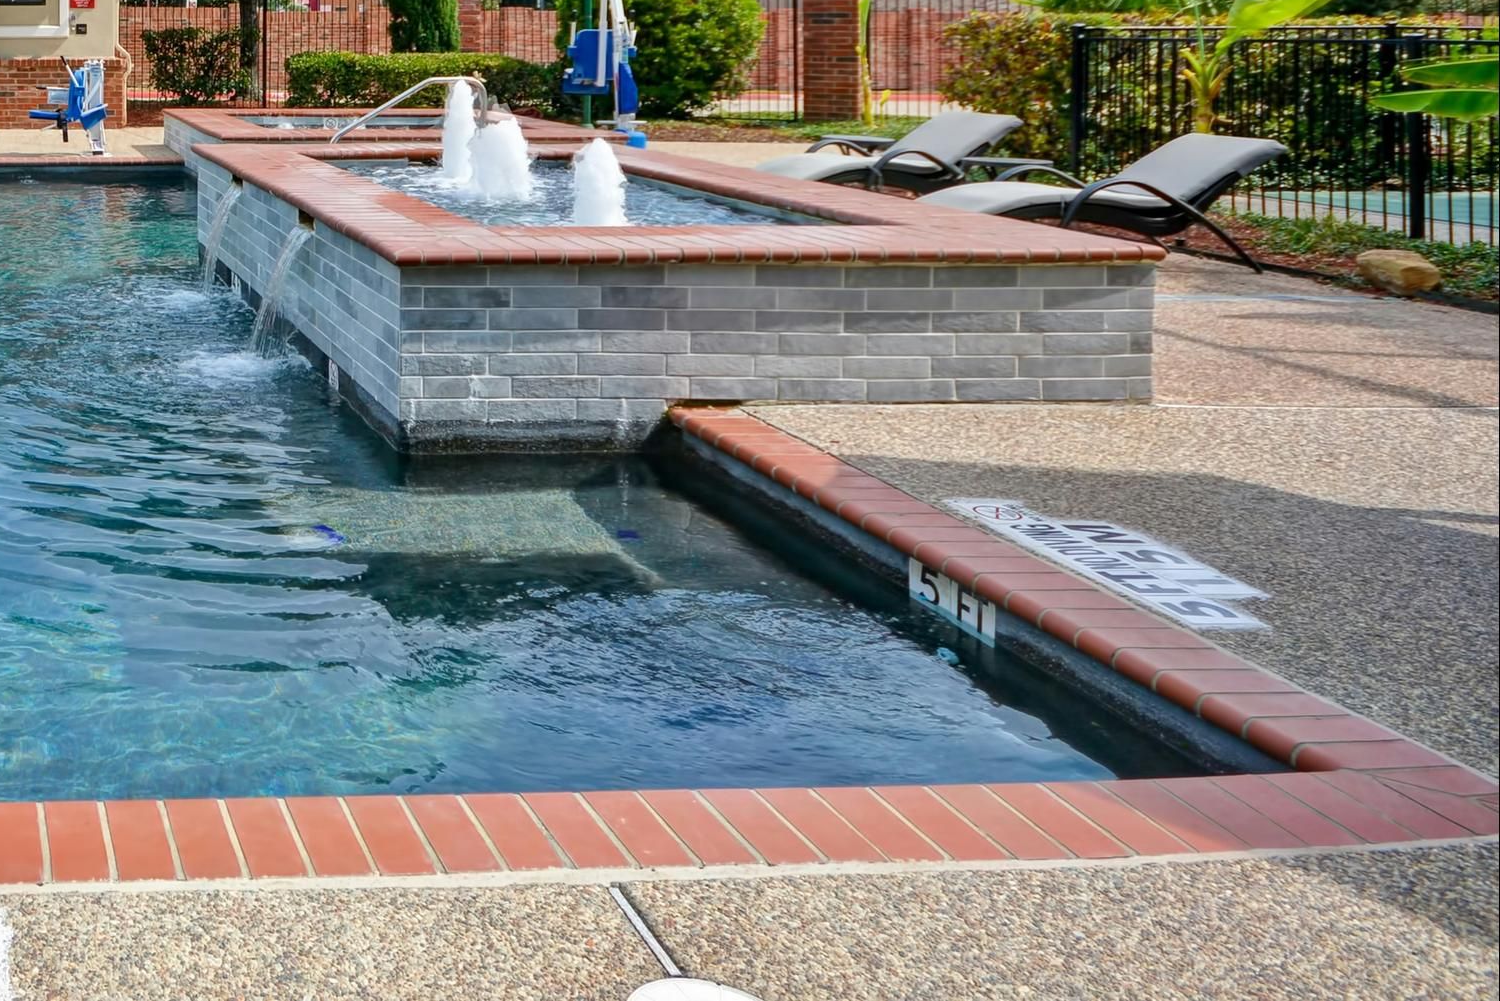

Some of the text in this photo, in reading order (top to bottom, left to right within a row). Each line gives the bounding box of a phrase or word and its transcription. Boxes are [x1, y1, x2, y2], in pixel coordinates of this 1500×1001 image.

[920, 564, 989, 635] 5 FT
[1160, 600, 1239, 619] 5
